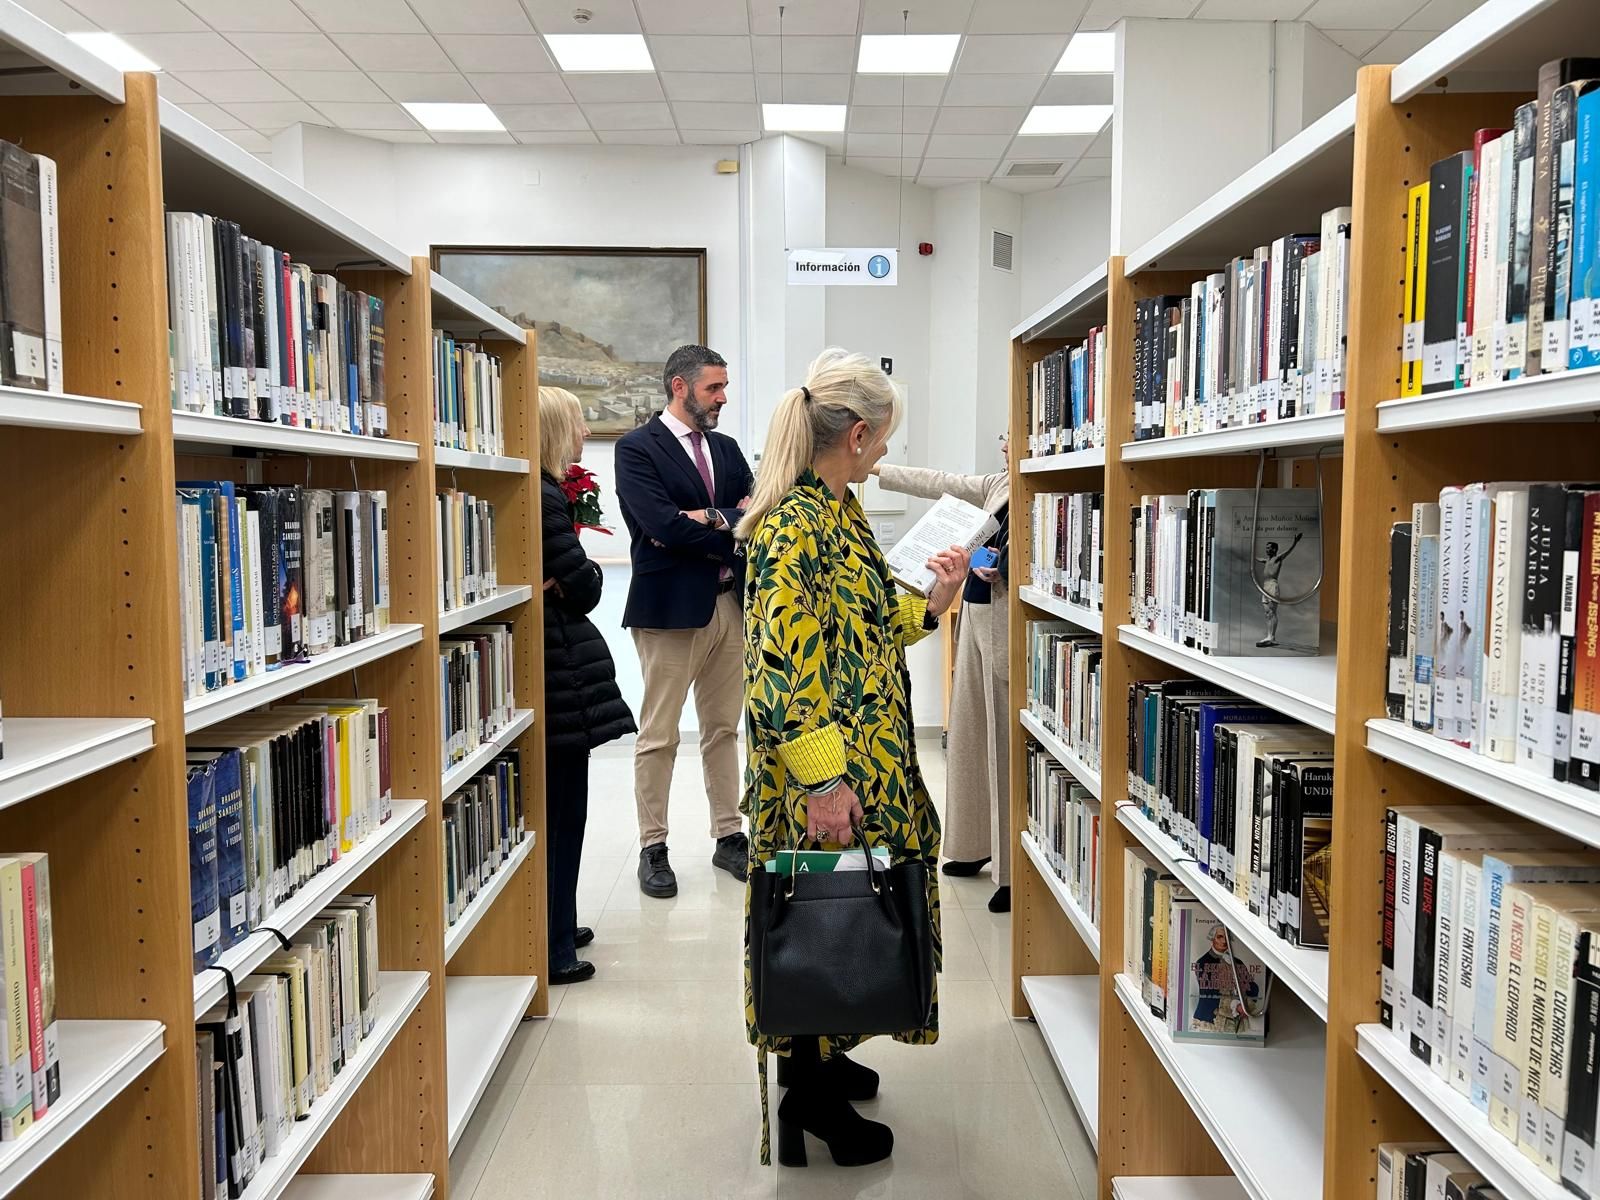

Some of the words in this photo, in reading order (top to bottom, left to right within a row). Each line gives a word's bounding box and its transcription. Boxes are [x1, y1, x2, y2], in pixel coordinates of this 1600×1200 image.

[1541, 101, 1551, 150] NAIPAUL
[796, 261, 861, 272] Información
[1536, 266, 1547, 298] vida
[255, 260, 265, 315] MALDITO
[1444, 503, 1453, 542] JULIA
[1465, 499, 1473, 538] JULIA
[1498, 519, 1508, 568] JULIA
[1527, 507, 1541, 601] NAVARRO
[1539, 524, 1551, 584] JULIA
[1591, 528, 1600, 575] FAMILIA
[1441, 545, 1451, 605] NAVARRO
[1461, 542, 1472, 604] NAVARRO
[1563, 574, 1574, 613] NAVARRO
[1409, 624, 1417, 636] El
[1493, 576, 1506, 660] NAVARRO
[1586, 601, 1599, 658] ASESINOS
[1538, 663, 1546, 705] HISTO
[1579, 734, 1592, 743] NAV
[1253, 815, 1261, 841] NOCHE
[1253, 843, 1260, 855] LA
[1401, 859, 1411, 905] CUCHILLO
[1440, 916, 1451, 931] LA
[1490, 908, 1501, 920] EL
[1512, 901, 1525, 919] JO
[1537, 916, 1550, 934] JO
[1438, 931, 1450, 983] ESTRELLA
[1460, 927, 1475, 989] FANTASMA
[1487, 922, 1500, 977] HEREDERO
[1509, 961, 1522, 977] EL
[1437, 984, 1448, 1005] DEL
[1533, 977, 1547, 992] EL
[1505, 977, 1520, 1043] LEOPARDO
[1530, 993, 1547, 1048] MUÑECO
[1549, 990, 1568, 1079] CUCARACHAS
[1528, 1047, 1543, 1065] DE
[1526, 1066, 1541, 1105] NIEVE
